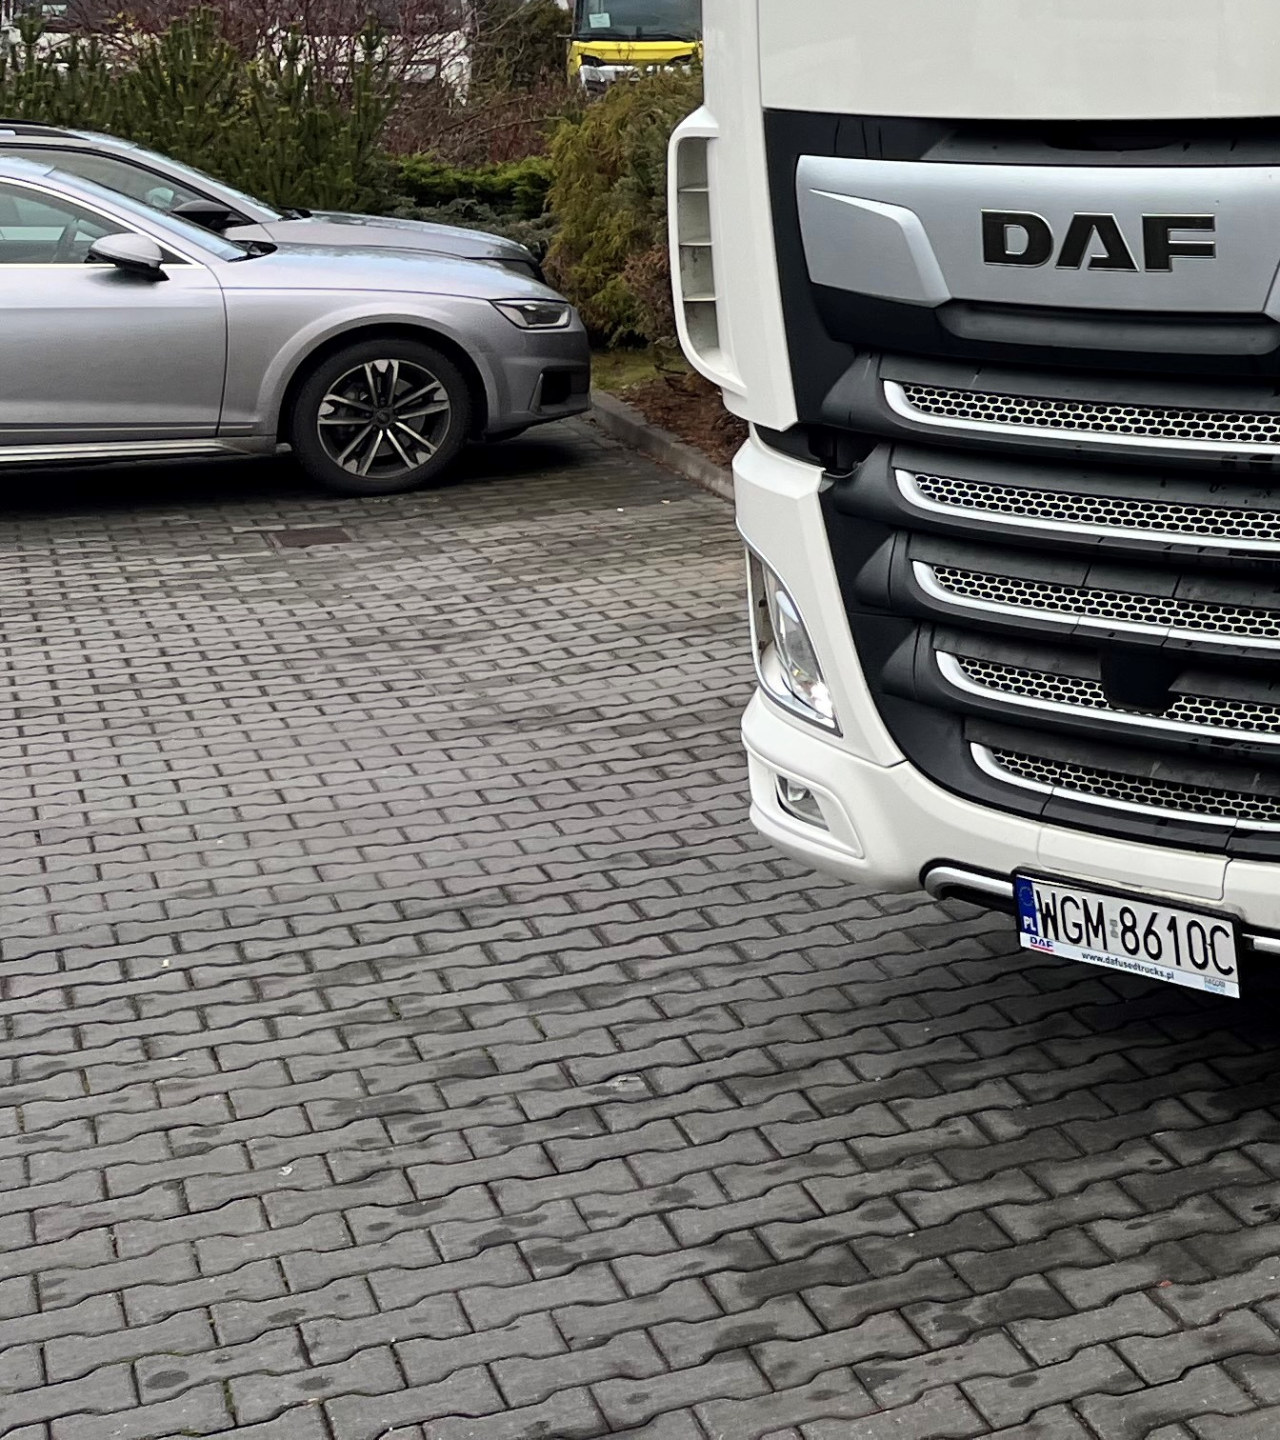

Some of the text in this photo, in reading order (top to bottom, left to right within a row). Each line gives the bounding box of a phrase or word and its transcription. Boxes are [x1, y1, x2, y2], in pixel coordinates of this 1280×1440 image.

[981, 209, 1216, 272] DAF
[1023, 915, 1037, 932] PL
[1036, 890, 1235, 976] WGM 8610C
[1081, 951, 1176, 980] www.dafusedtrucks.pl
